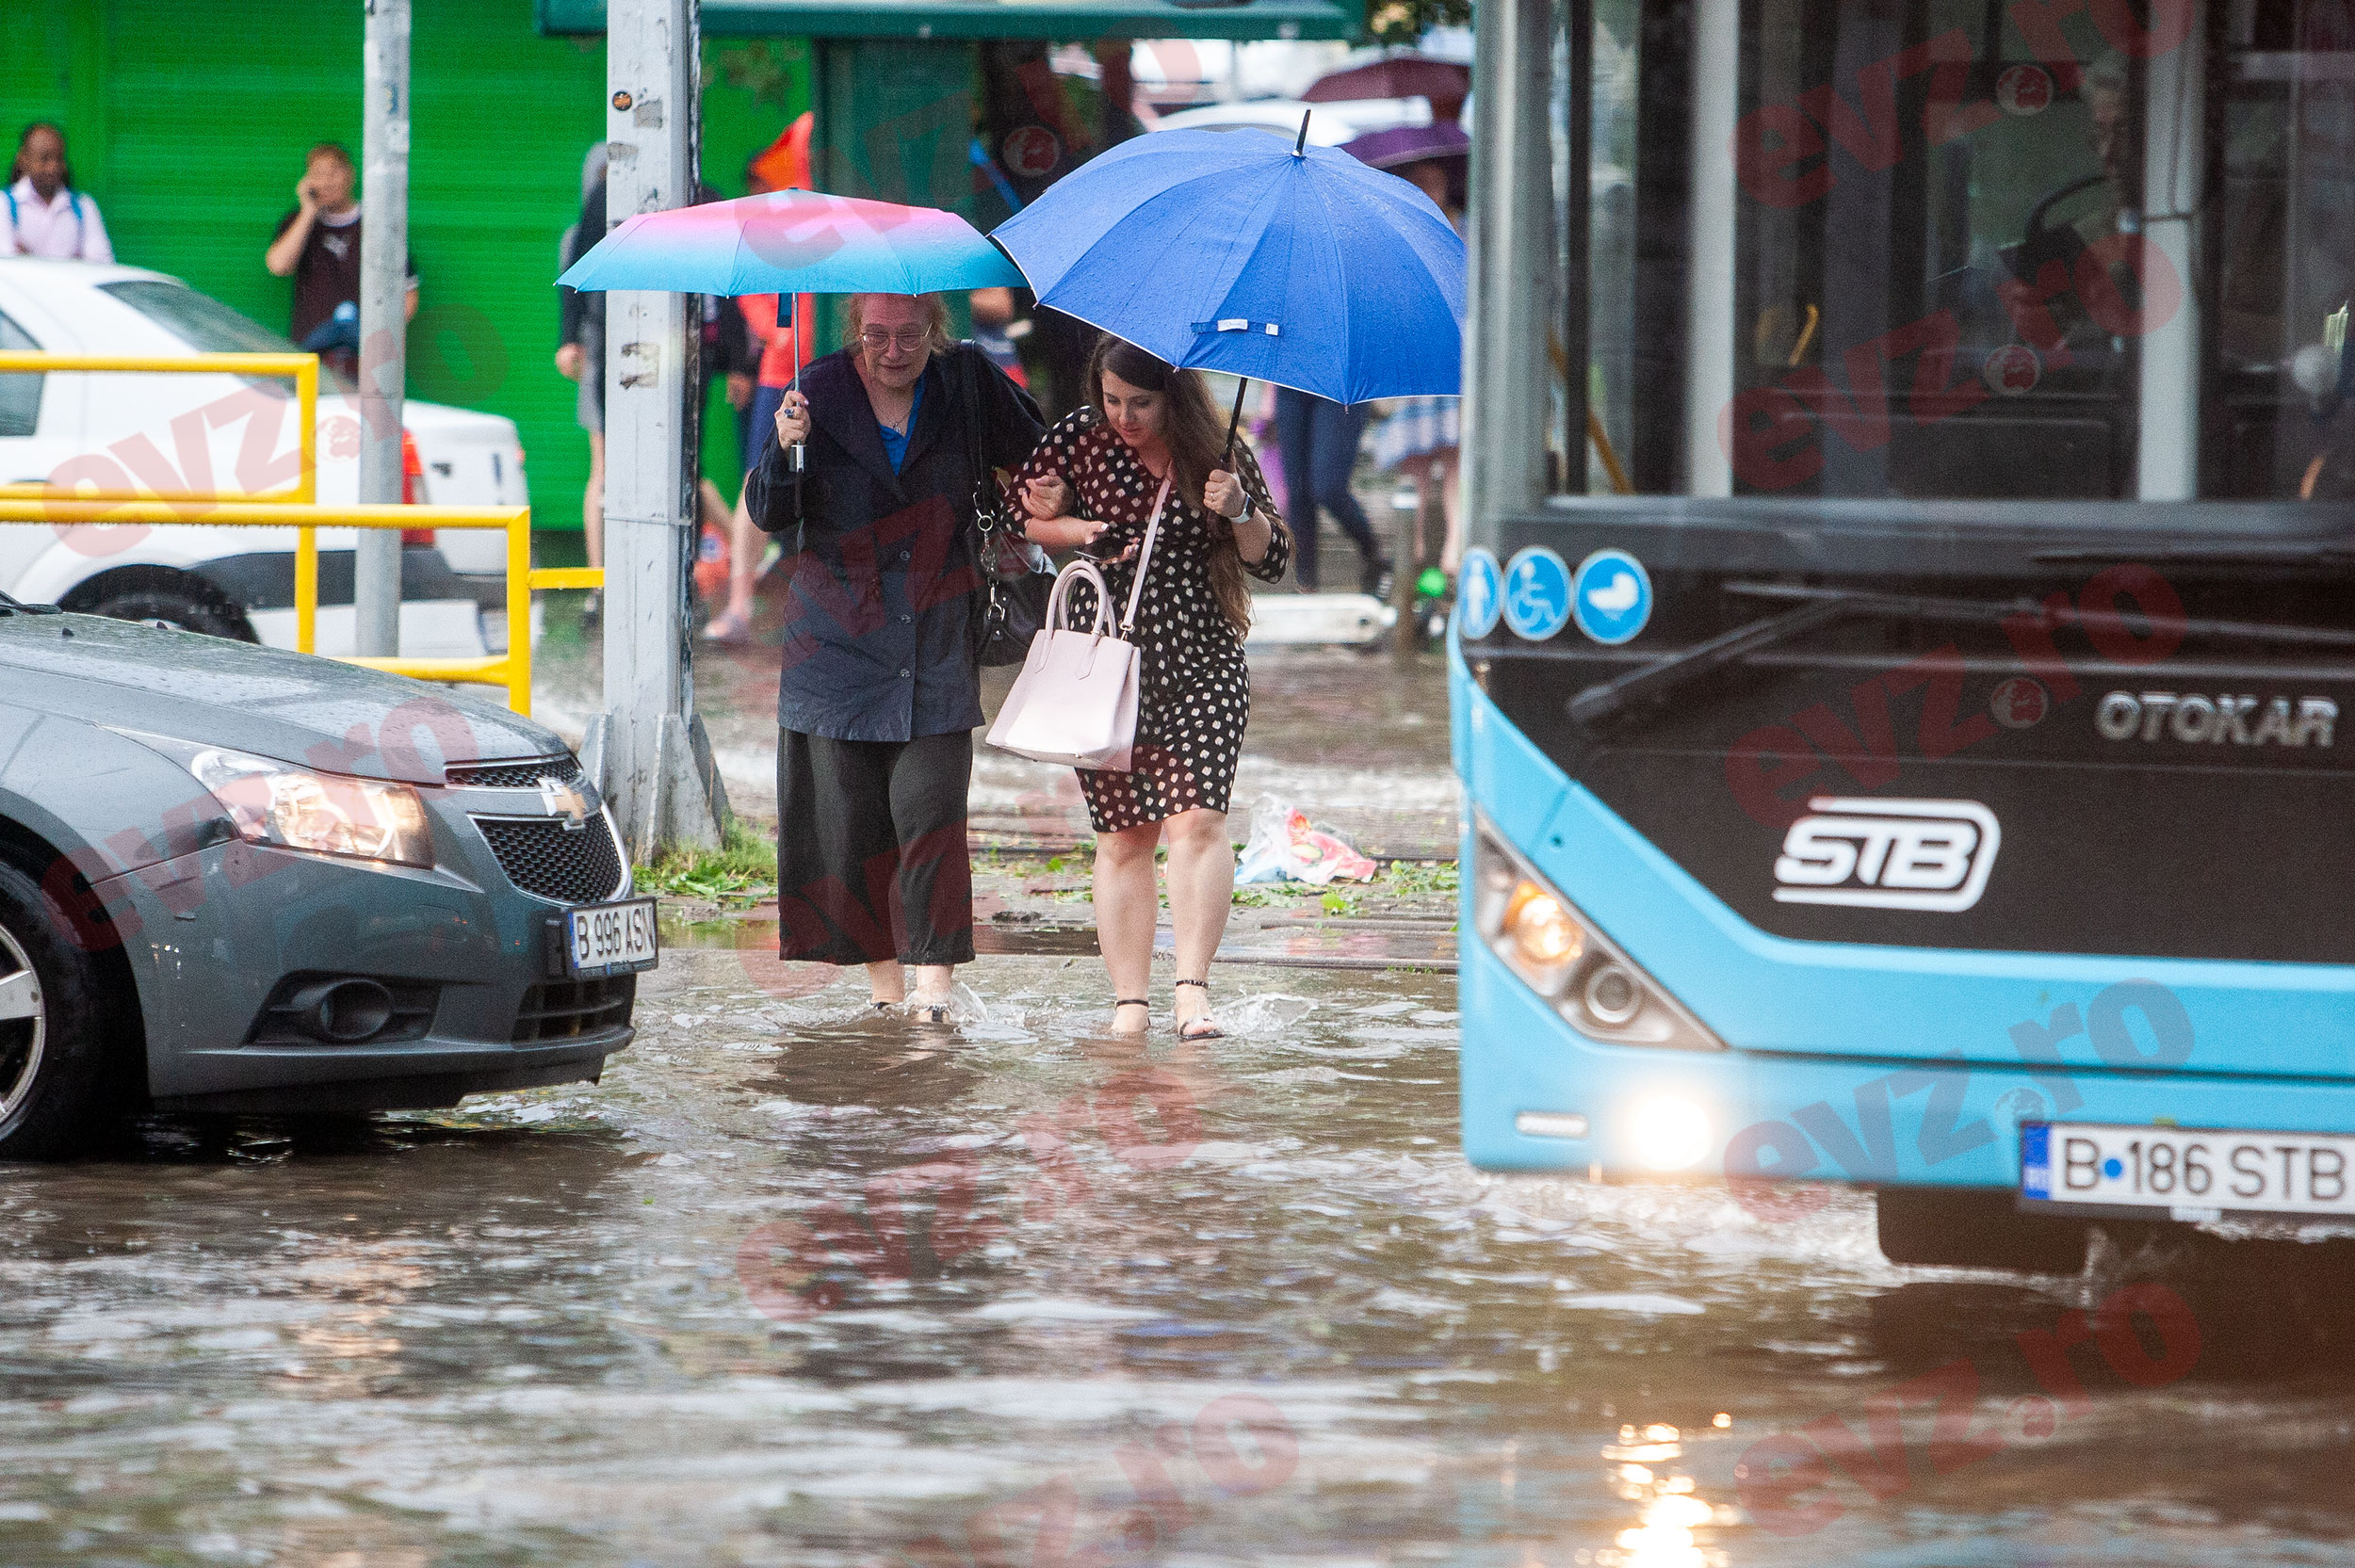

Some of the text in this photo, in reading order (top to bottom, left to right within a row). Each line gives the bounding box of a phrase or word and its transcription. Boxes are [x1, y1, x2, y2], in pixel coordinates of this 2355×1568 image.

[2095, 691, 2339, 747] OTOKAR
[1774, 812, 1979, 892] STB
[577, 907, 655, 960] B 996 ASN
[2063, 1137, 2348, 1203] B 186 STB
